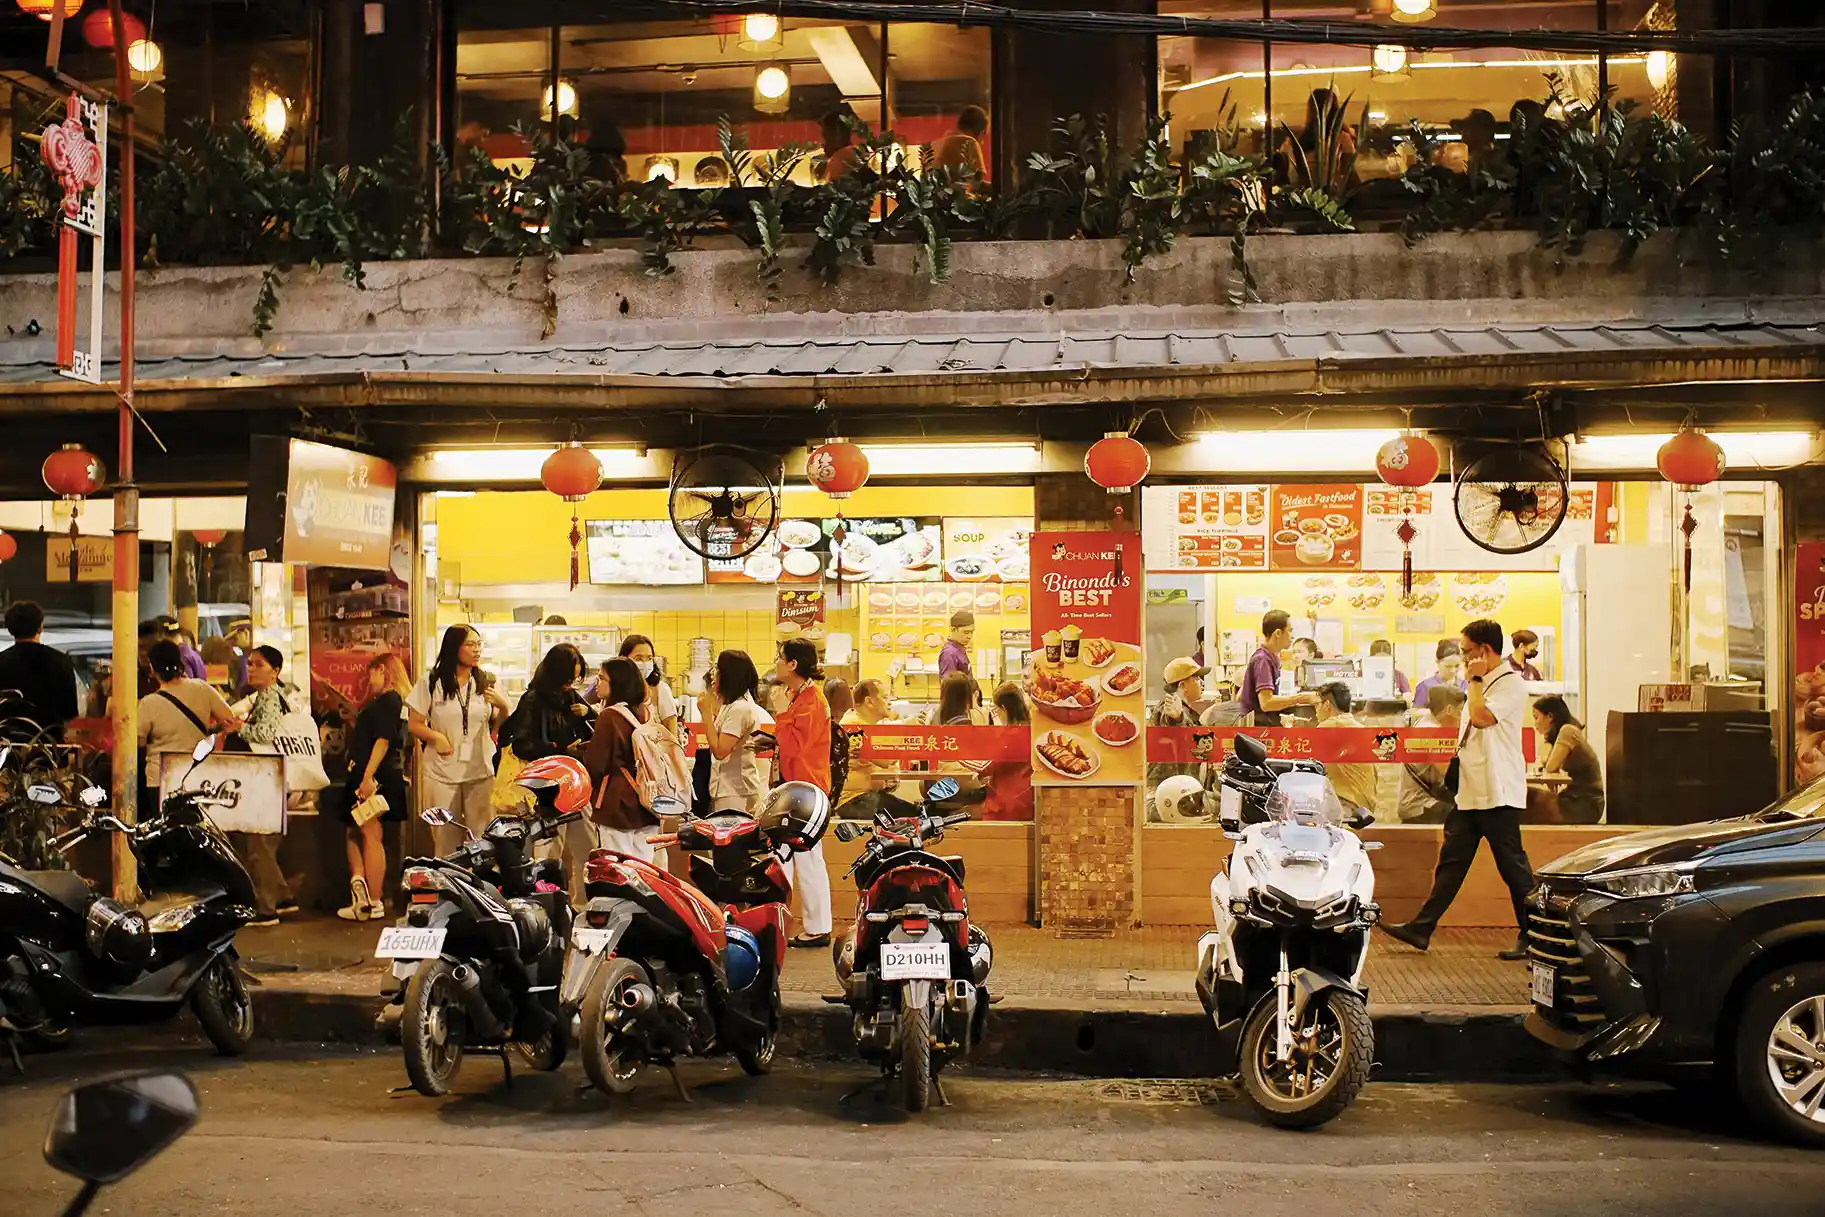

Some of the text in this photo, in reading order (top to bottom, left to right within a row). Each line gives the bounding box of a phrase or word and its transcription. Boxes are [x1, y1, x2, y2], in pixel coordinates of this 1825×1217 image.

[1281, 490, 1357, 507] Oldest Fastfood
[363, 502, 386, 527] KEE
[953, 533, 985, 543] SOUP
[1066, 552, 1099, 560] CHUAN
[1059, 590, 1113, 606] BEST
[782, 604, 819, 618] Dimsum
[329, 663, 367, 673] CHUAN
[1333, 670, 1359, 678] NOTICE
[924, 735, 959, 752] 泉记
[1277, 737, 1313, 754] 泉记
[1438, 739, 1456, 747] KEE
[381, 935, 440, 952] 165UHX
[886, 953, 945, 966] D210HH
